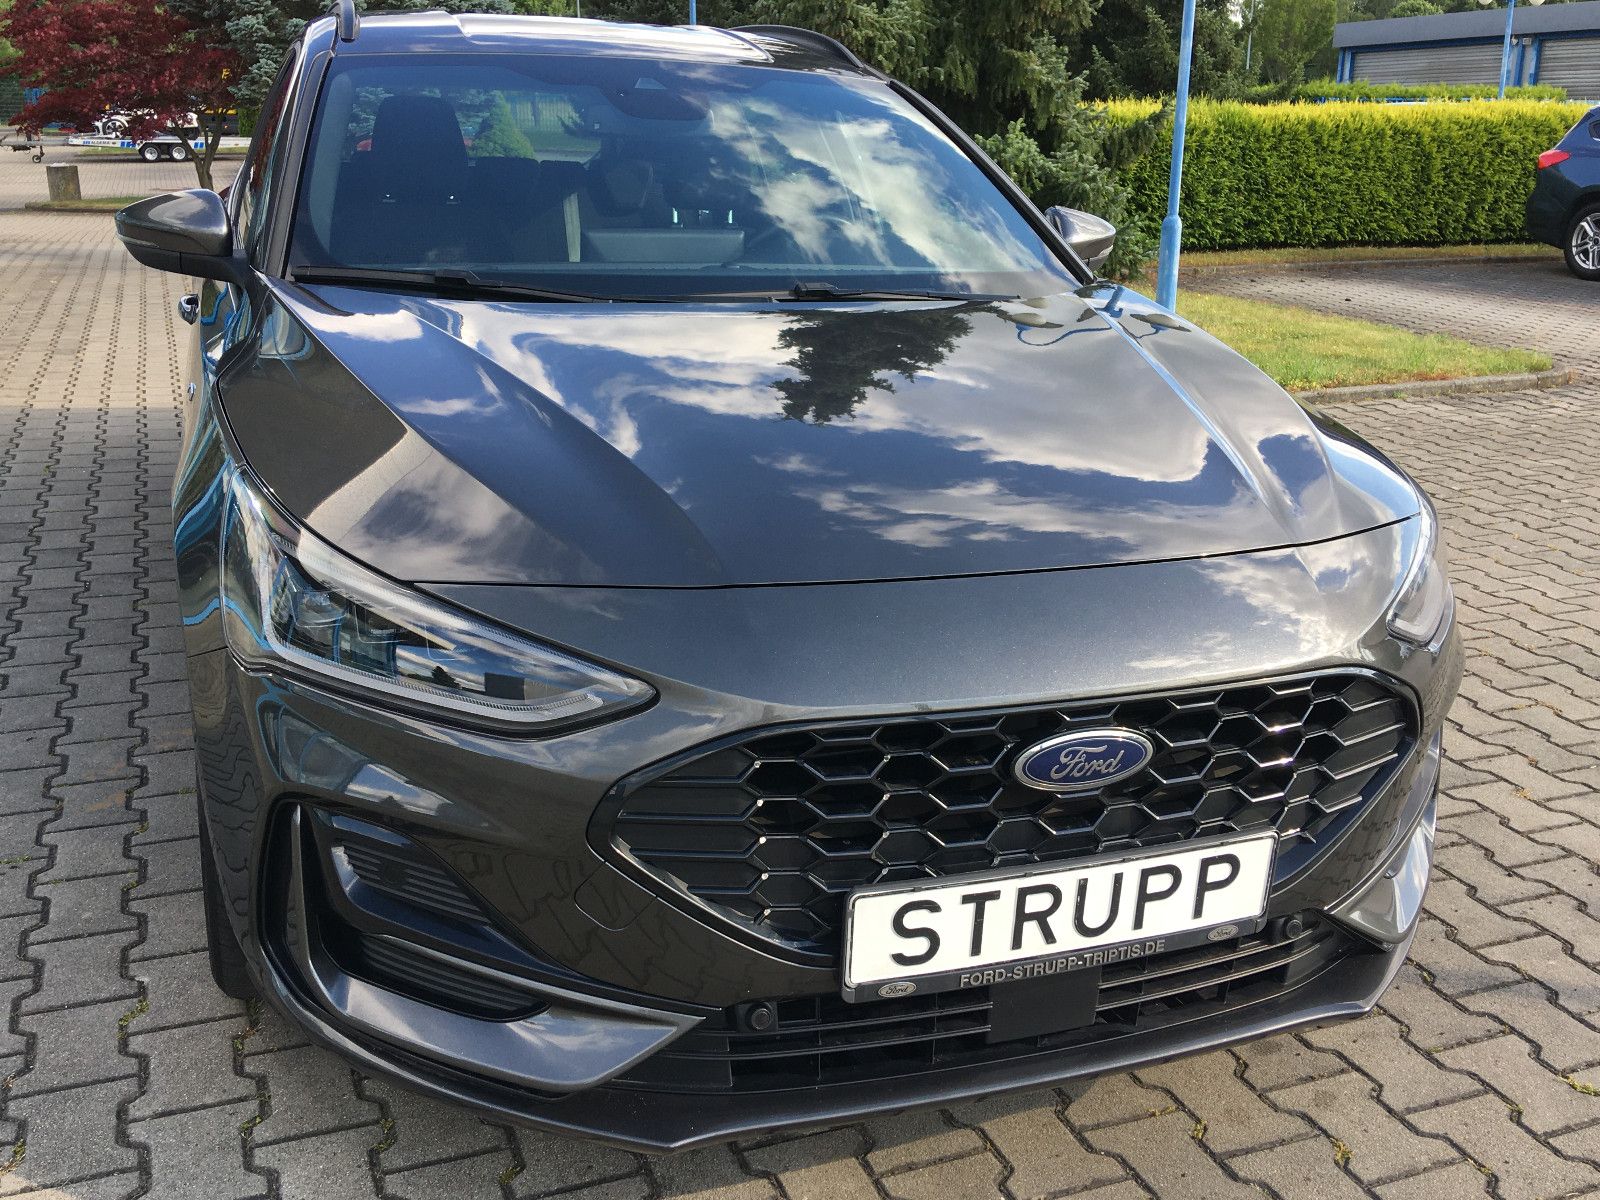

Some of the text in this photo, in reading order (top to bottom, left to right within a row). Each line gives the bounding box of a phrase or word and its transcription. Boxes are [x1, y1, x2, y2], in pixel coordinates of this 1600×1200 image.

[1050, 745, 1122, 780] Ford
[890, 853, 1241, 966] STRUPP
[960, 940, 1166, 988] FORD-STRUPP-TRIPTIS.DE
